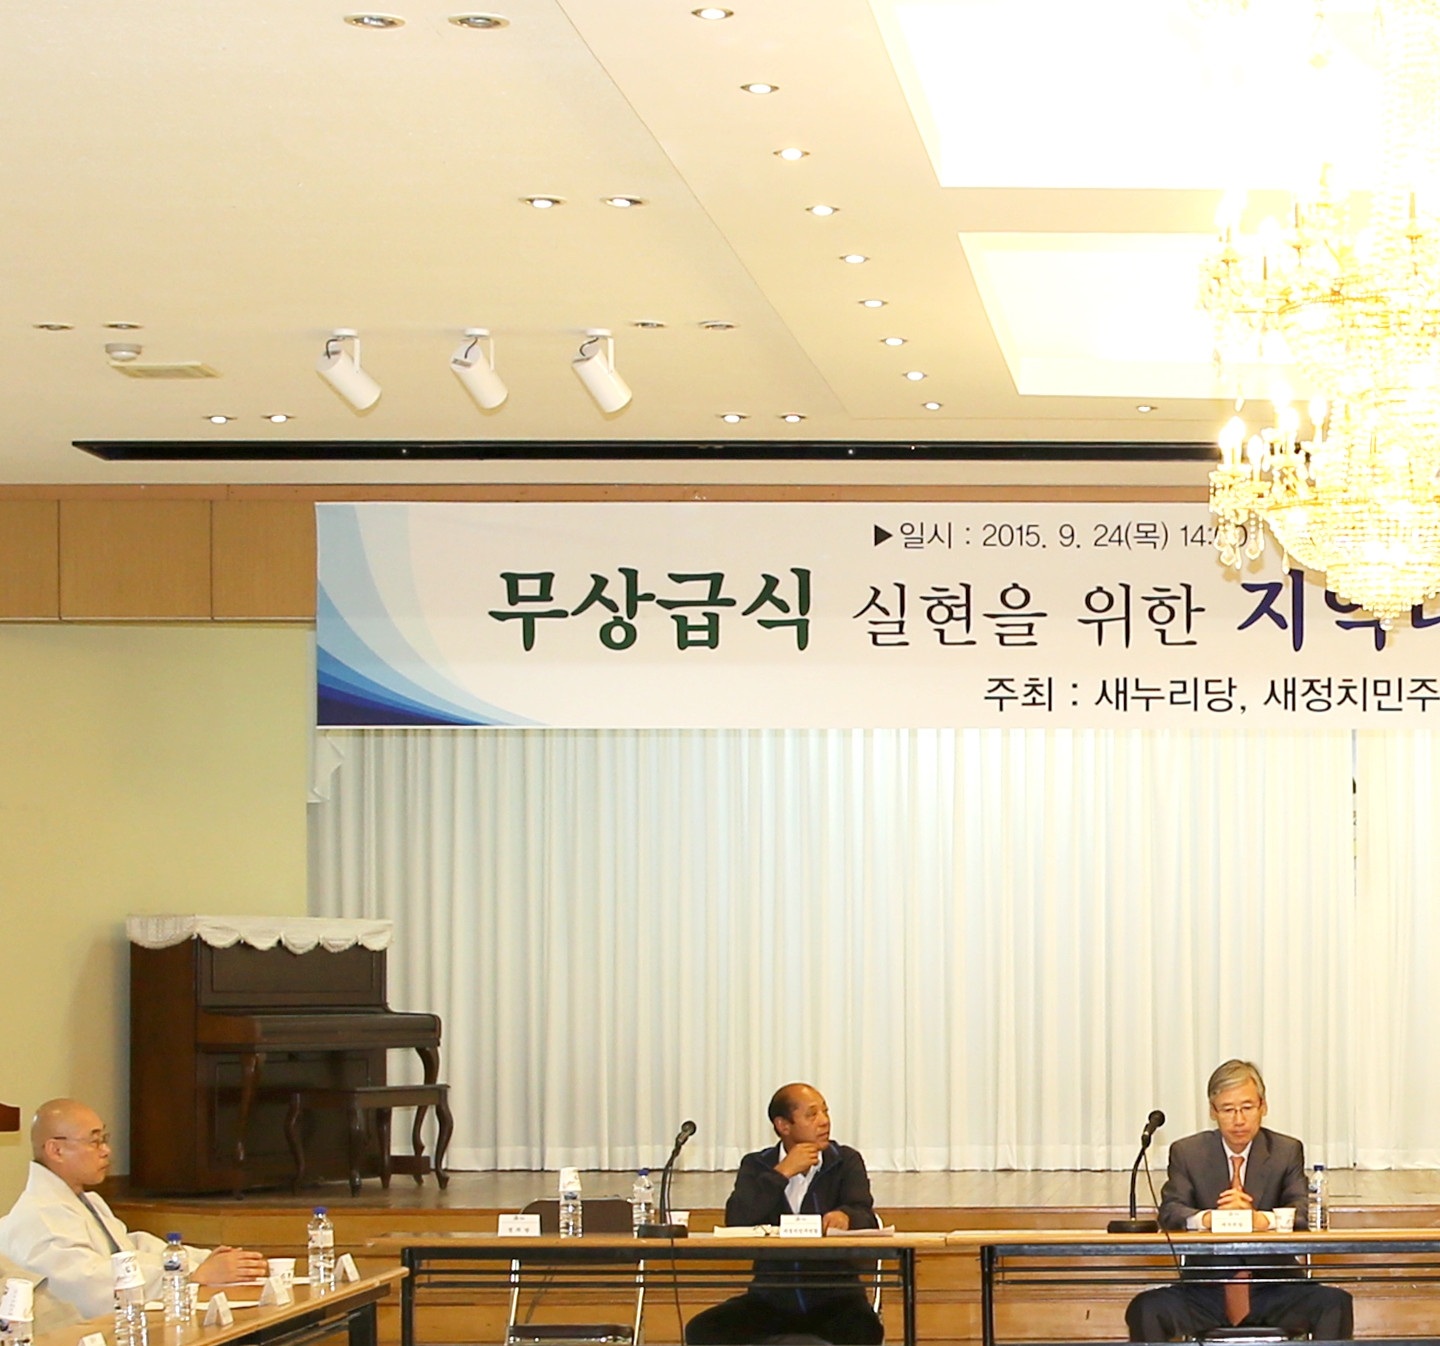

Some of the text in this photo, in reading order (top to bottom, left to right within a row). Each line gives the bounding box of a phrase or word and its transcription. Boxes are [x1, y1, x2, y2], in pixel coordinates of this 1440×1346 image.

[900, 522, 952, 549] 일시
[982, 523, 1046, 549] 2015.
[1059, 523, 1081, 549] 9.
[1093, 522, 1169, 550] 24(목)
[1180, 524, 1248, 548] 14:0
[488, 567, 811, 652] 무상급식
[853, 582, 1048, 647] 실현을
[1077, 582, 1206, 649] 위한
[984, 676, 1052, 712] 주최
[1094, 677, 1246, 714] 새누리당,
